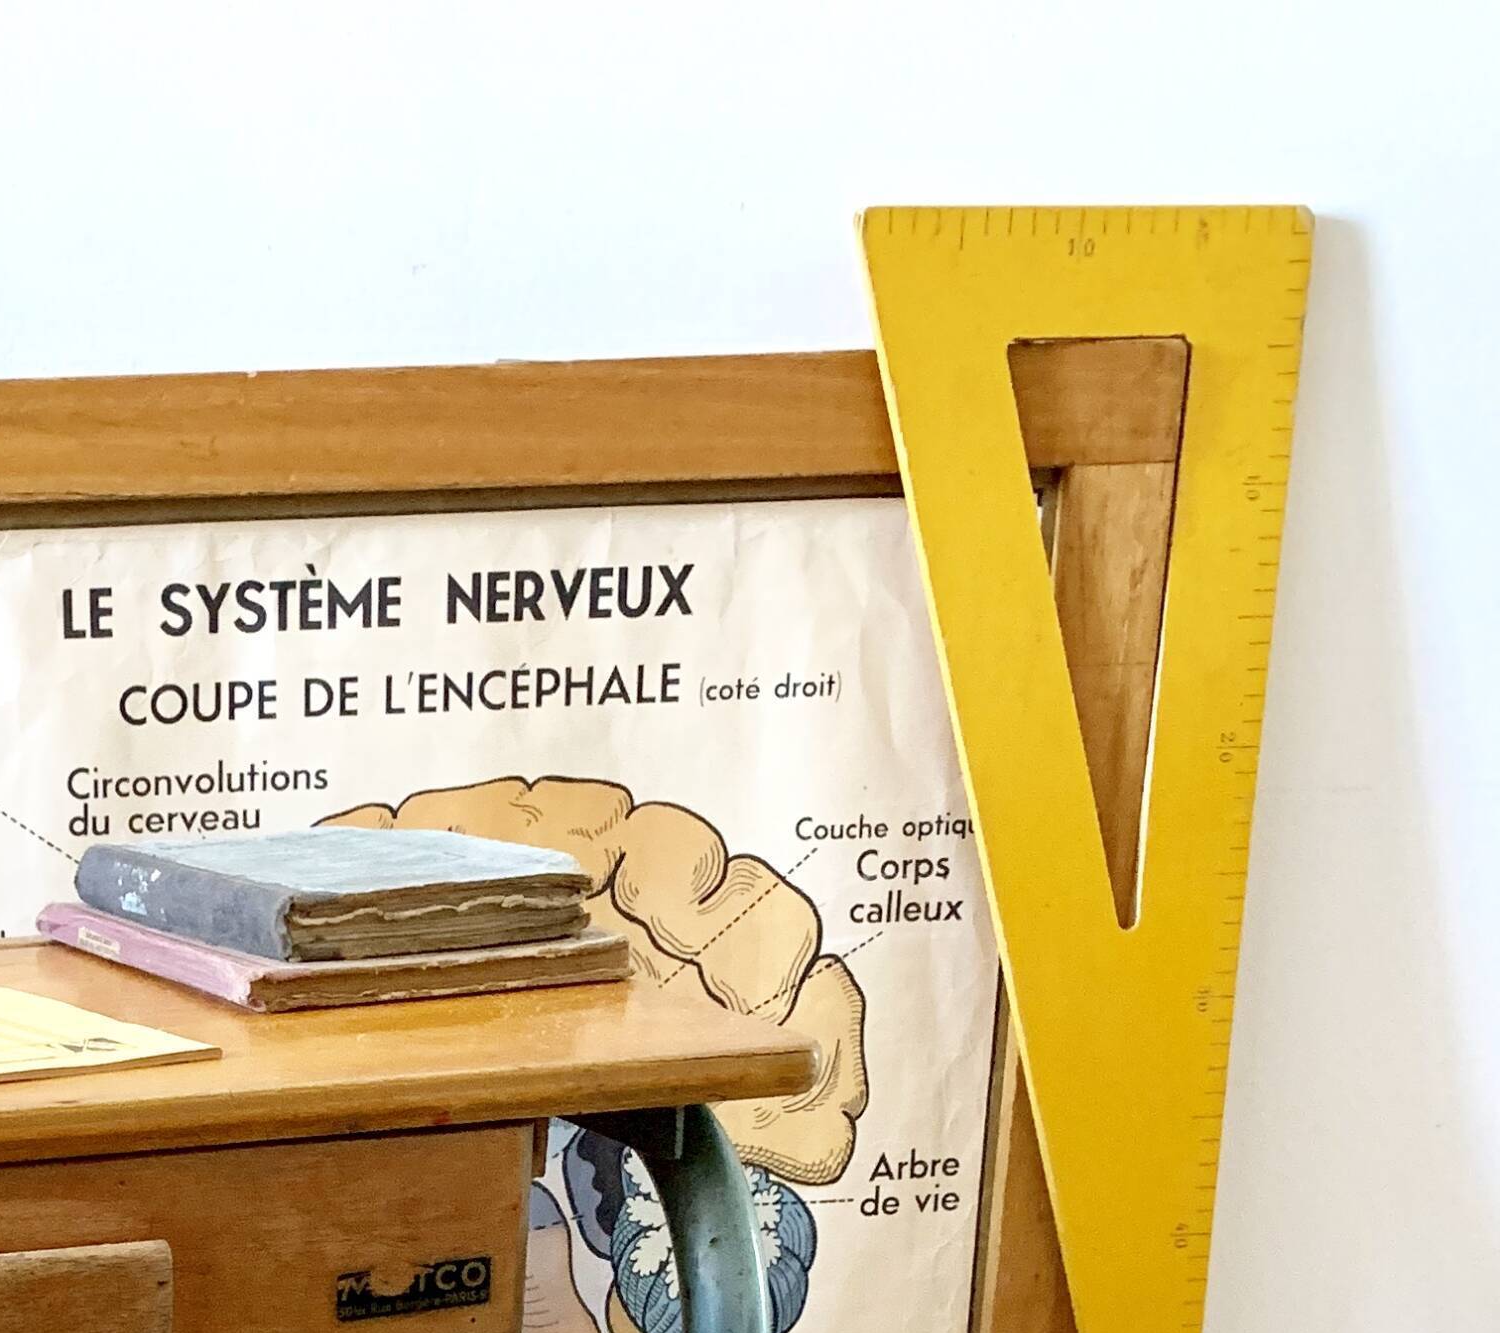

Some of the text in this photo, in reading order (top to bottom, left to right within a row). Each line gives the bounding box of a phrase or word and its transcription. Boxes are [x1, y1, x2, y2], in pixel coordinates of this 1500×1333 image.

[61, 562, 696, 640] LE SYSTÈME NERVEUX
[119, 680, 278, 727] COUPE
[303, 677, 359, 719] DE
[384, 662, 682, 716] L'ENCÉPHALE
[773, 669, 843, 703] droit)
[66, 758, 330, 801] Circonvolutions
[67, 804, 262, 838] du cerveau
[794, 812, 974, 843] Couche optiq
[856, 848, 951, 881] Corps
[848, 890, 964, 925] calleux
[869, 1147, 961, 1182] Arbre
[859, 1184, 961, 1216] de vie
[337, 1261, 487, 1303] MTCO
